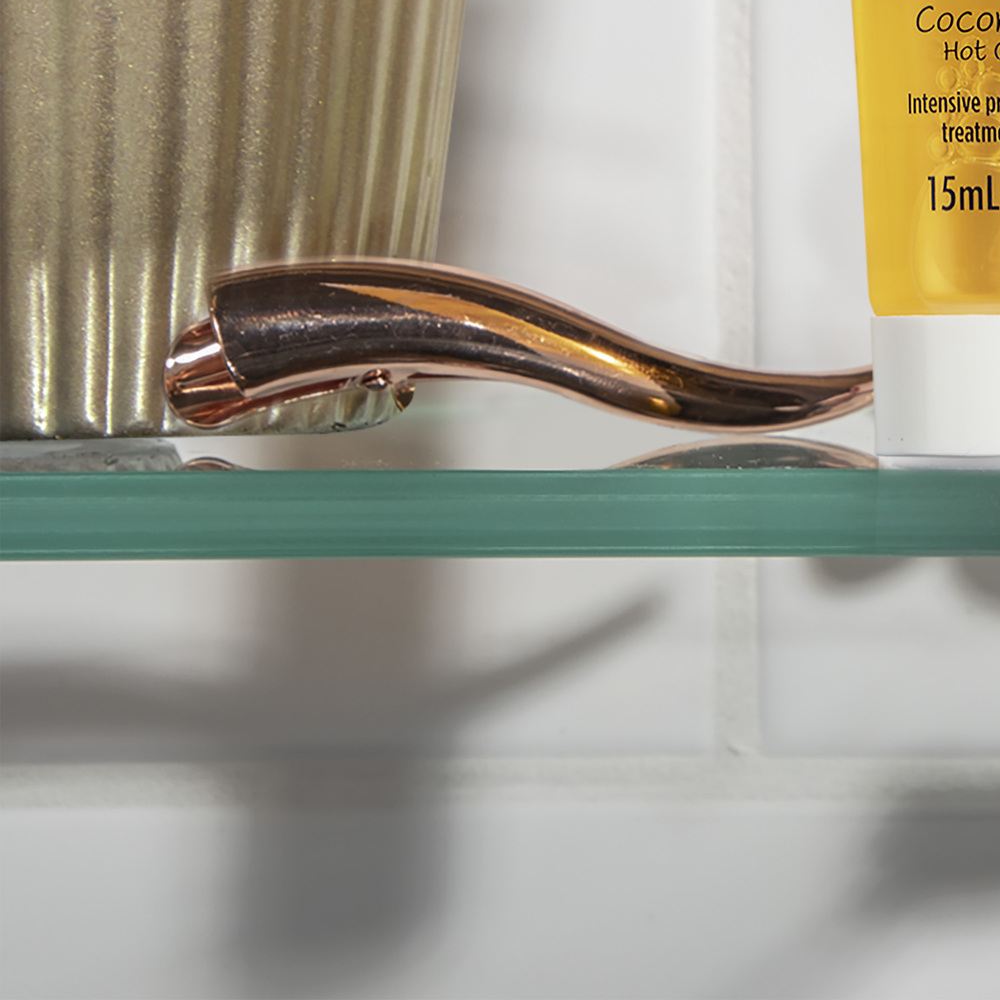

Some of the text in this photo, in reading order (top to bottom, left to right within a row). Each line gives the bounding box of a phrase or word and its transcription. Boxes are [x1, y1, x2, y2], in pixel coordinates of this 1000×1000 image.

[944, 40, 986, 62] Hot
[908, 92, 981, 115] Intensive
[928, 174, 1000, 212] 15mL
